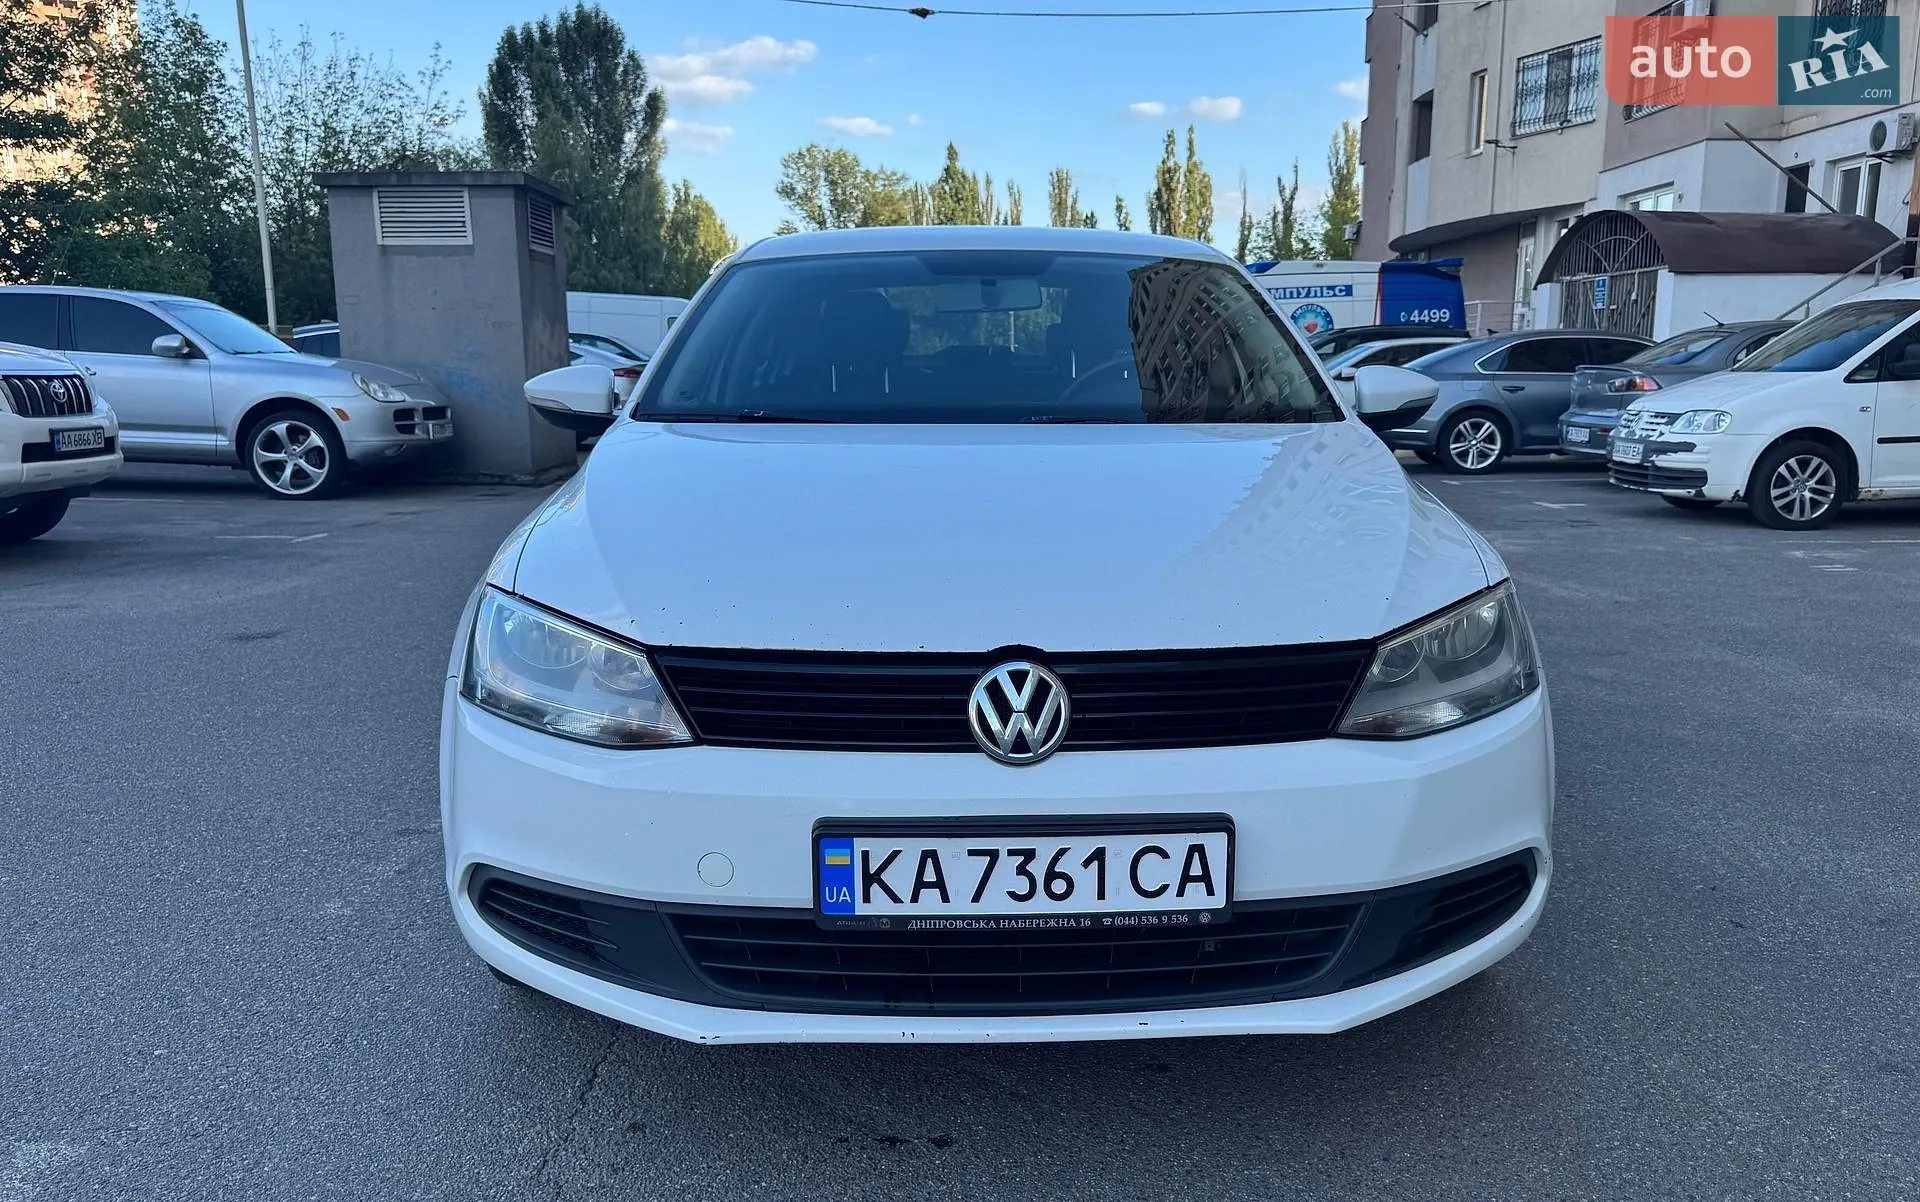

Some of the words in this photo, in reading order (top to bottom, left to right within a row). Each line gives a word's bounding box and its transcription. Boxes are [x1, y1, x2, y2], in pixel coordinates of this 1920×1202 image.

[1267, 286, 1347, 299] МПУЛЬС
[1409, 308, 1450, 323] 4499
[860, 848, 951, 904] KA
[966, 846, 1106, 904] 7361
[1129, 843, 1216, 899] CA
[825, 886, 852, 903] UA
[907, 919, 997, 930] ДНІПРОВСЬКА
[999, 918, 1077, 929] НАБЕРЕЖНА
[1079, 918, 1091, 928] 16
[1114, 916, 1139, 926] (044)
[1141, 915, 1159, 925] 536
[1161, 915, 1168, 925] 9
[1170, 914, 1188, 924] 536
